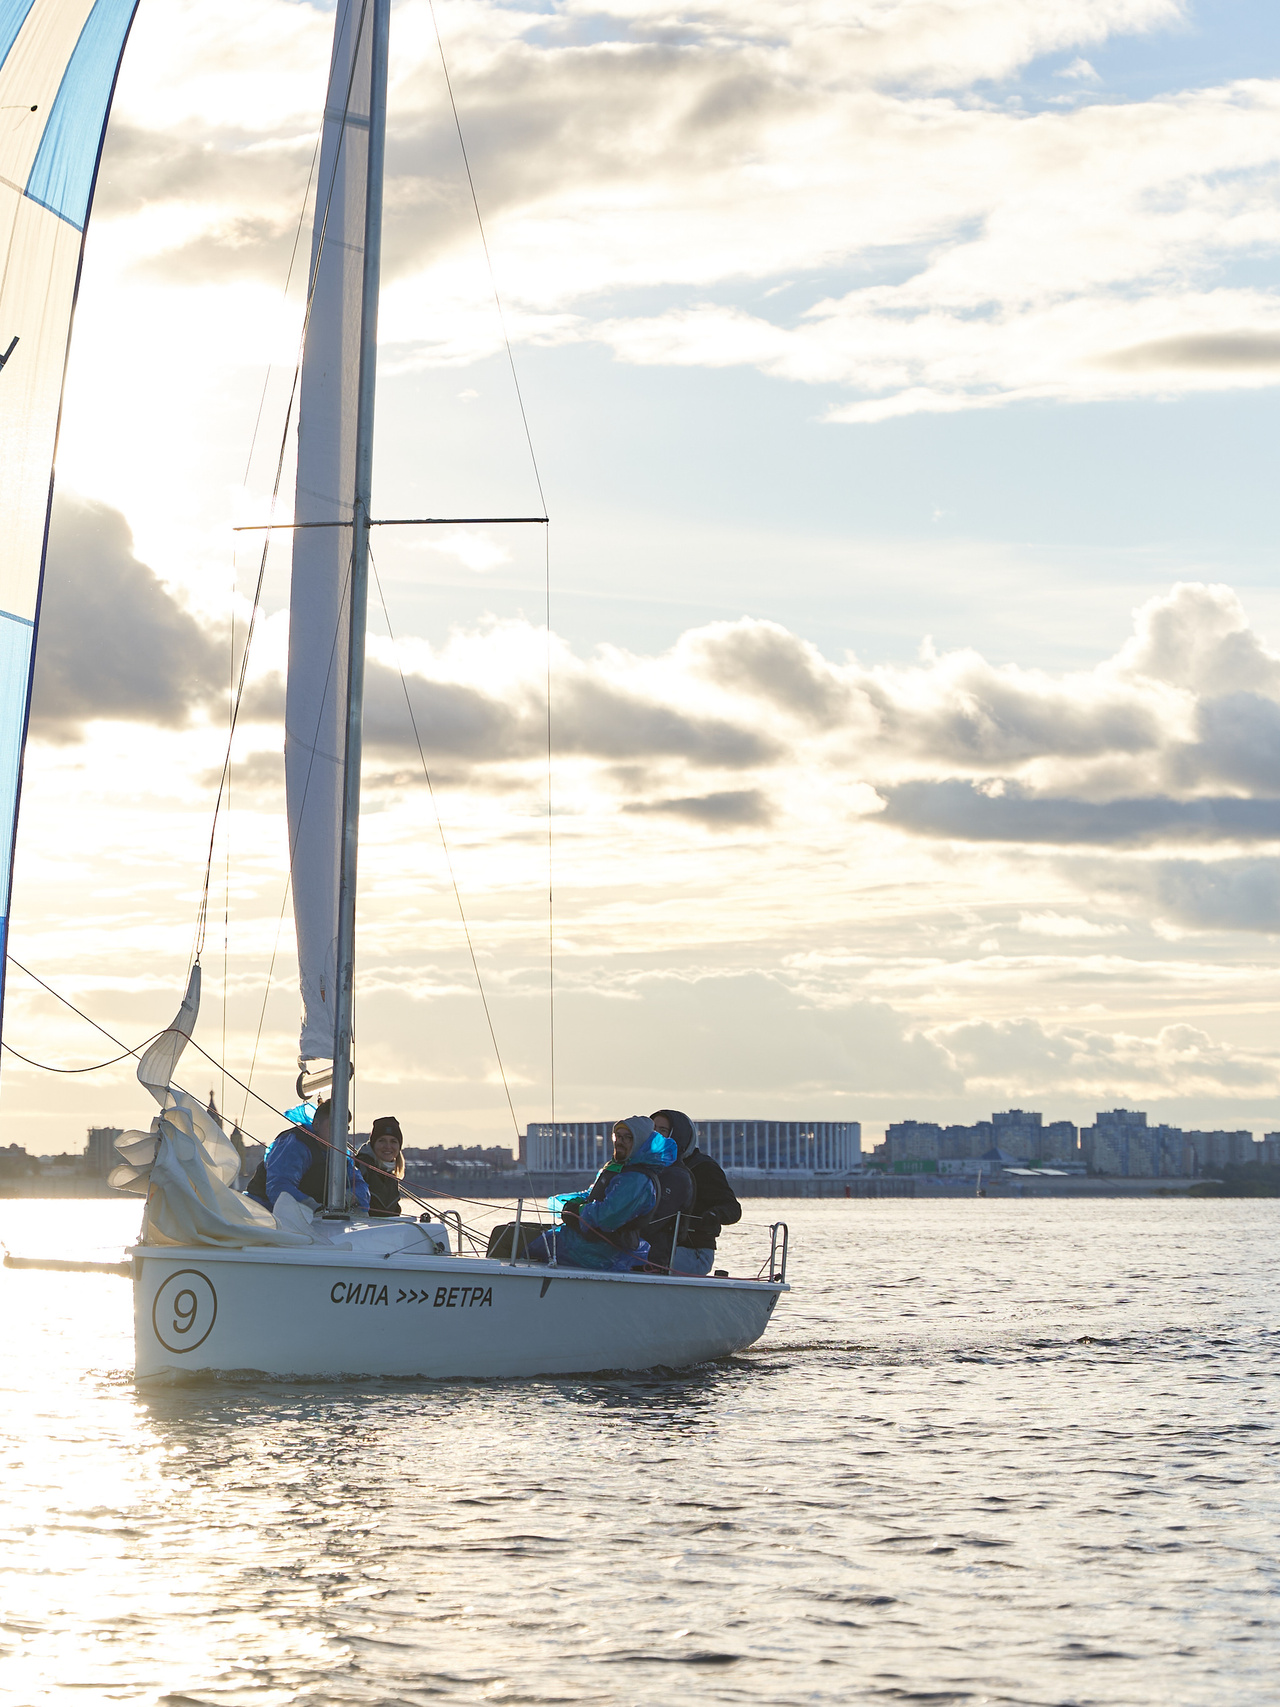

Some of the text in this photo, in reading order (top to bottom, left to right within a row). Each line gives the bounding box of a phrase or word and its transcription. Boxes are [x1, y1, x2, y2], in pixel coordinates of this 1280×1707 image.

[330, 1281, 389, 1306] СИЛА
[433, 1287, 493, 1307] ВЕТРА
[766, 1294, 777, 1312] 9
[173, 1289, 198, 1334] 9
